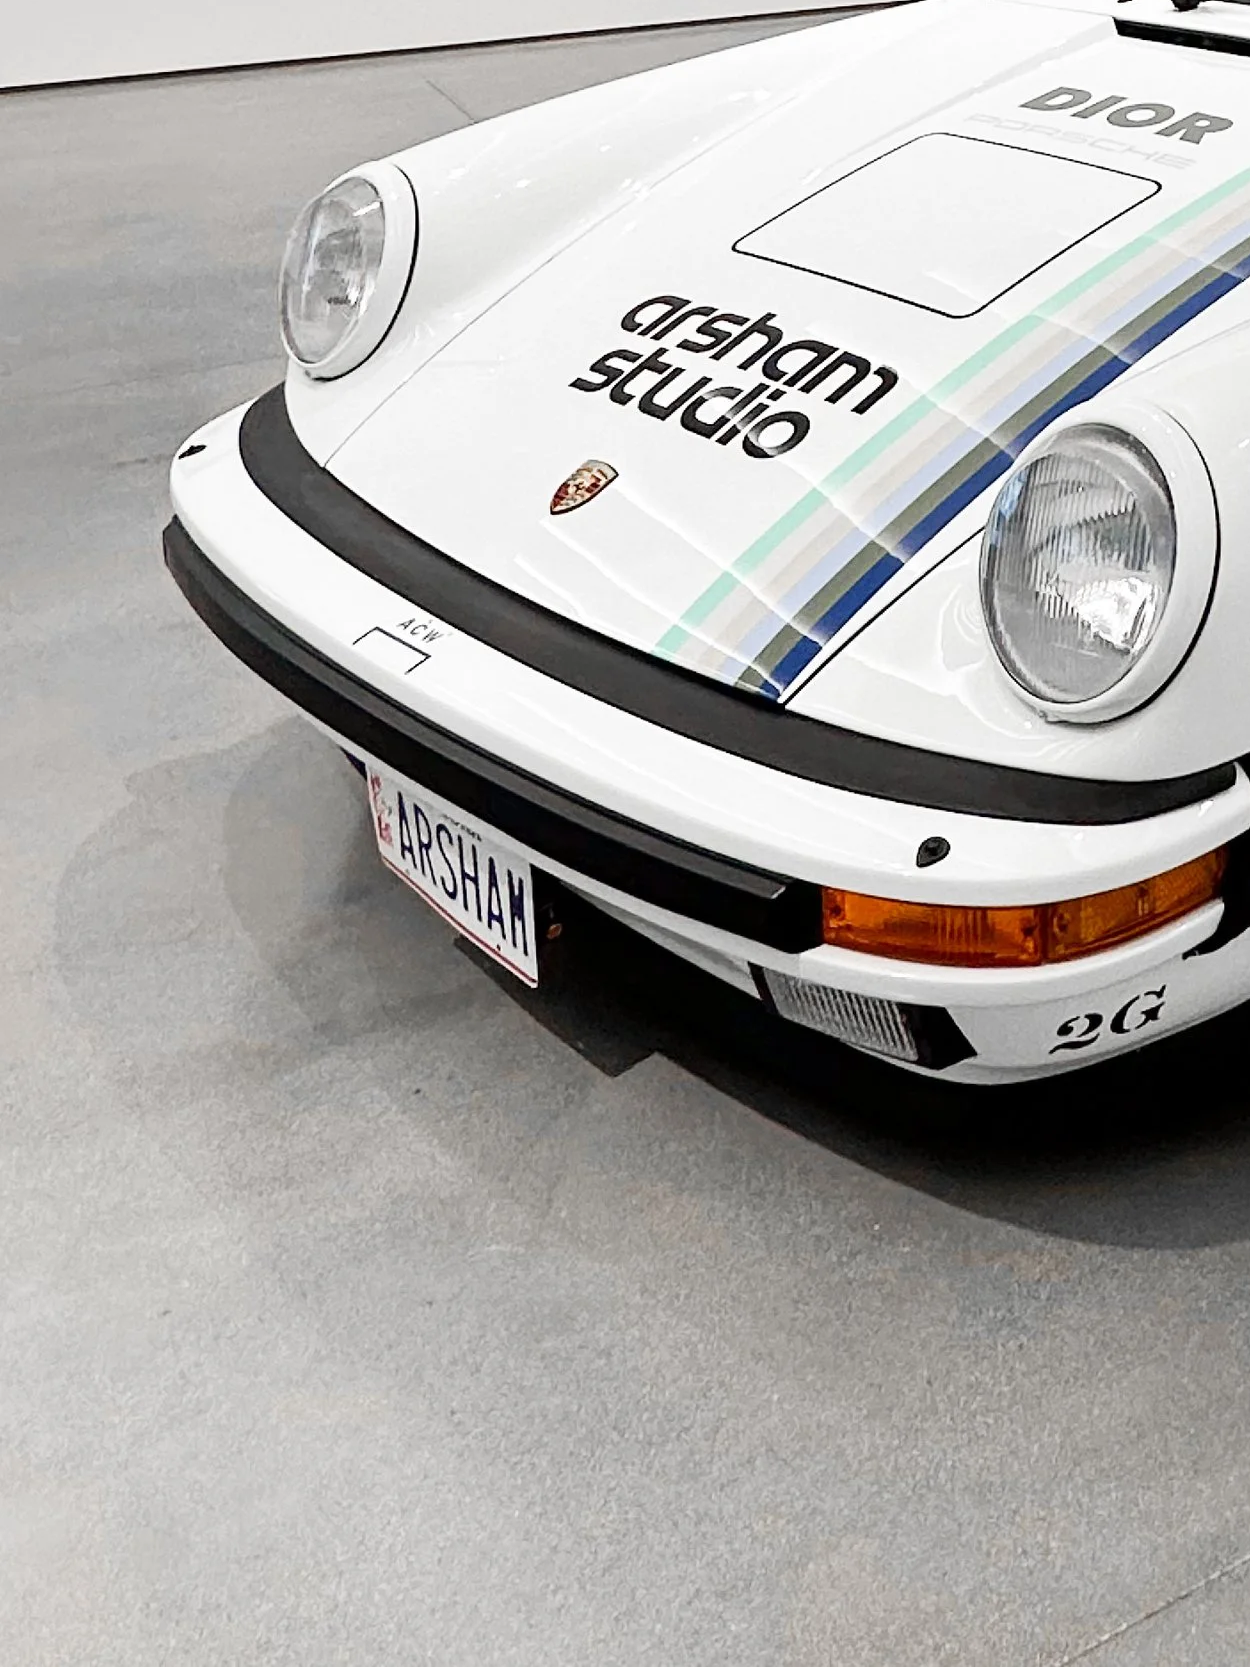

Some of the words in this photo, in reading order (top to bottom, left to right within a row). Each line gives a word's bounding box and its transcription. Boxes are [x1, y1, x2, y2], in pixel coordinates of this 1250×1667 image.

[964, 113, 1197, 171] PORSCHE
[1018, 86, 1234, 145] DIOR
[568, 345, 810, 458] studio
[619, 295, 898, 415] arsham
[397, 790, 529, 956] ARSHAM
